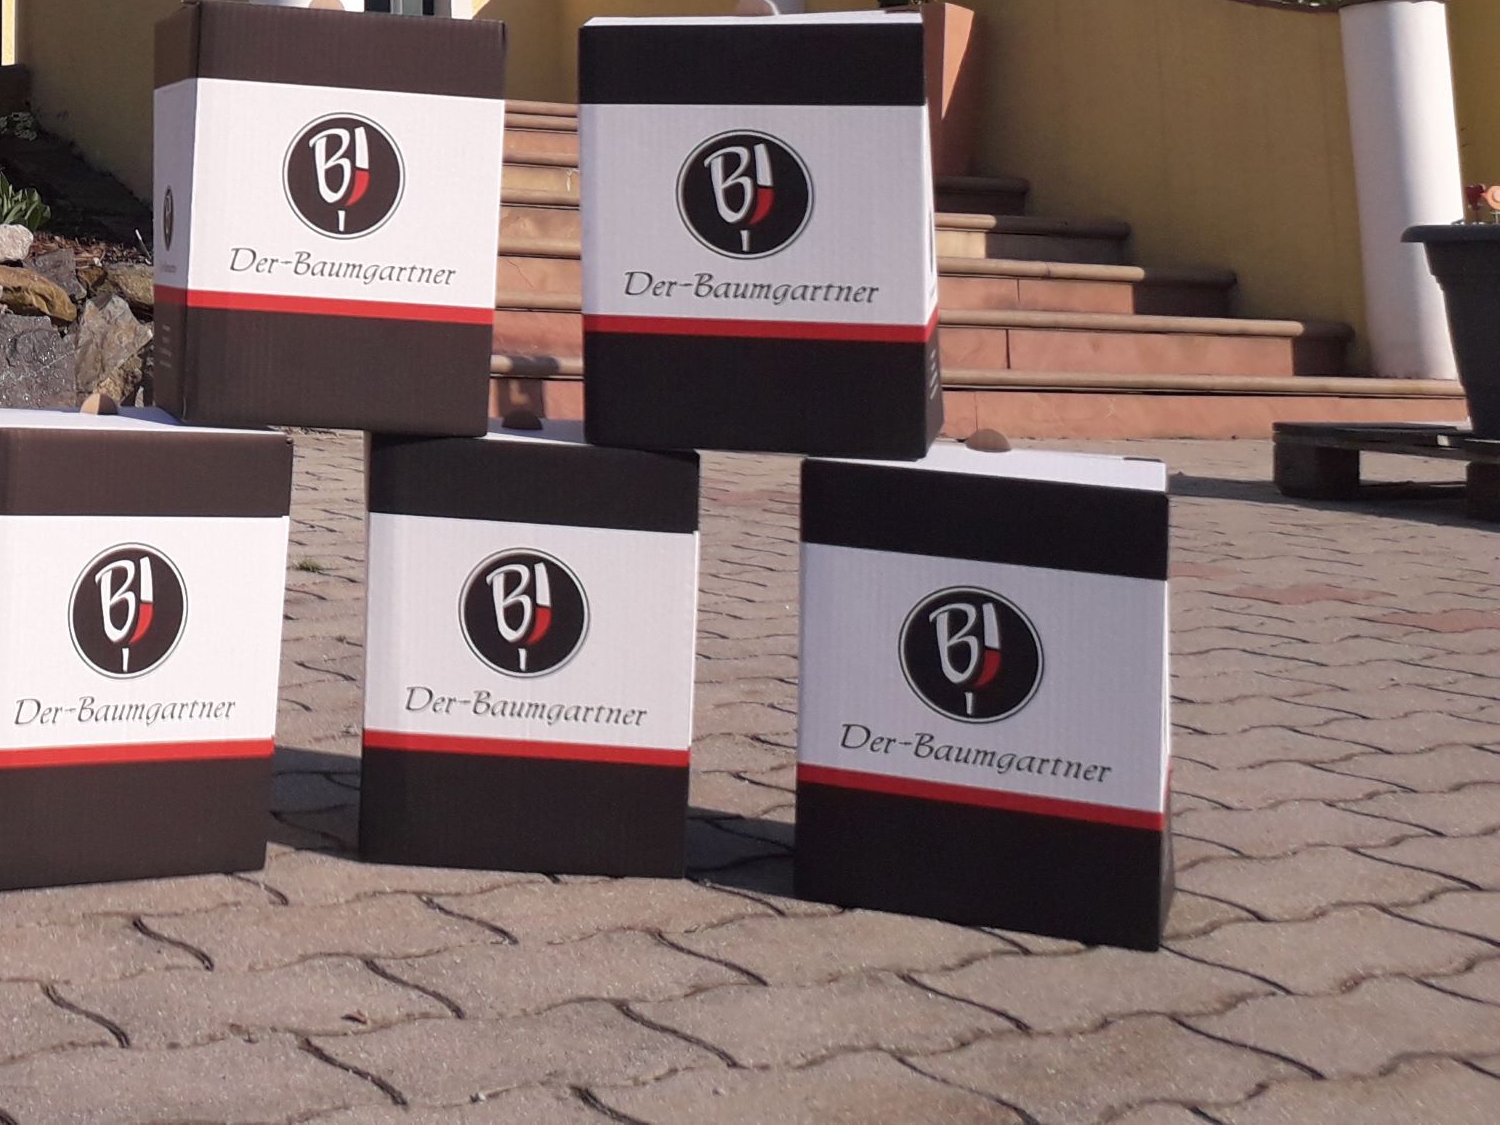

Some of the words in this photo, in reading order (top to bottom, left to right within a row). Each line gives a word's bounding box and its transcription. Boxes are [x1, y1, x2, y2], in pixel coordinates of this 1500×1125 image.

[229, 247, 457, 287] Der-Baumgartner
[623, 271, 880, 306] Der-Baumgartner
[13, 695, 237, 727] Der-Baumgartner
[404, 685, 648, 727] Der-Baumgartner
[839, 723, 1113, 784] Der-Baumgartner
